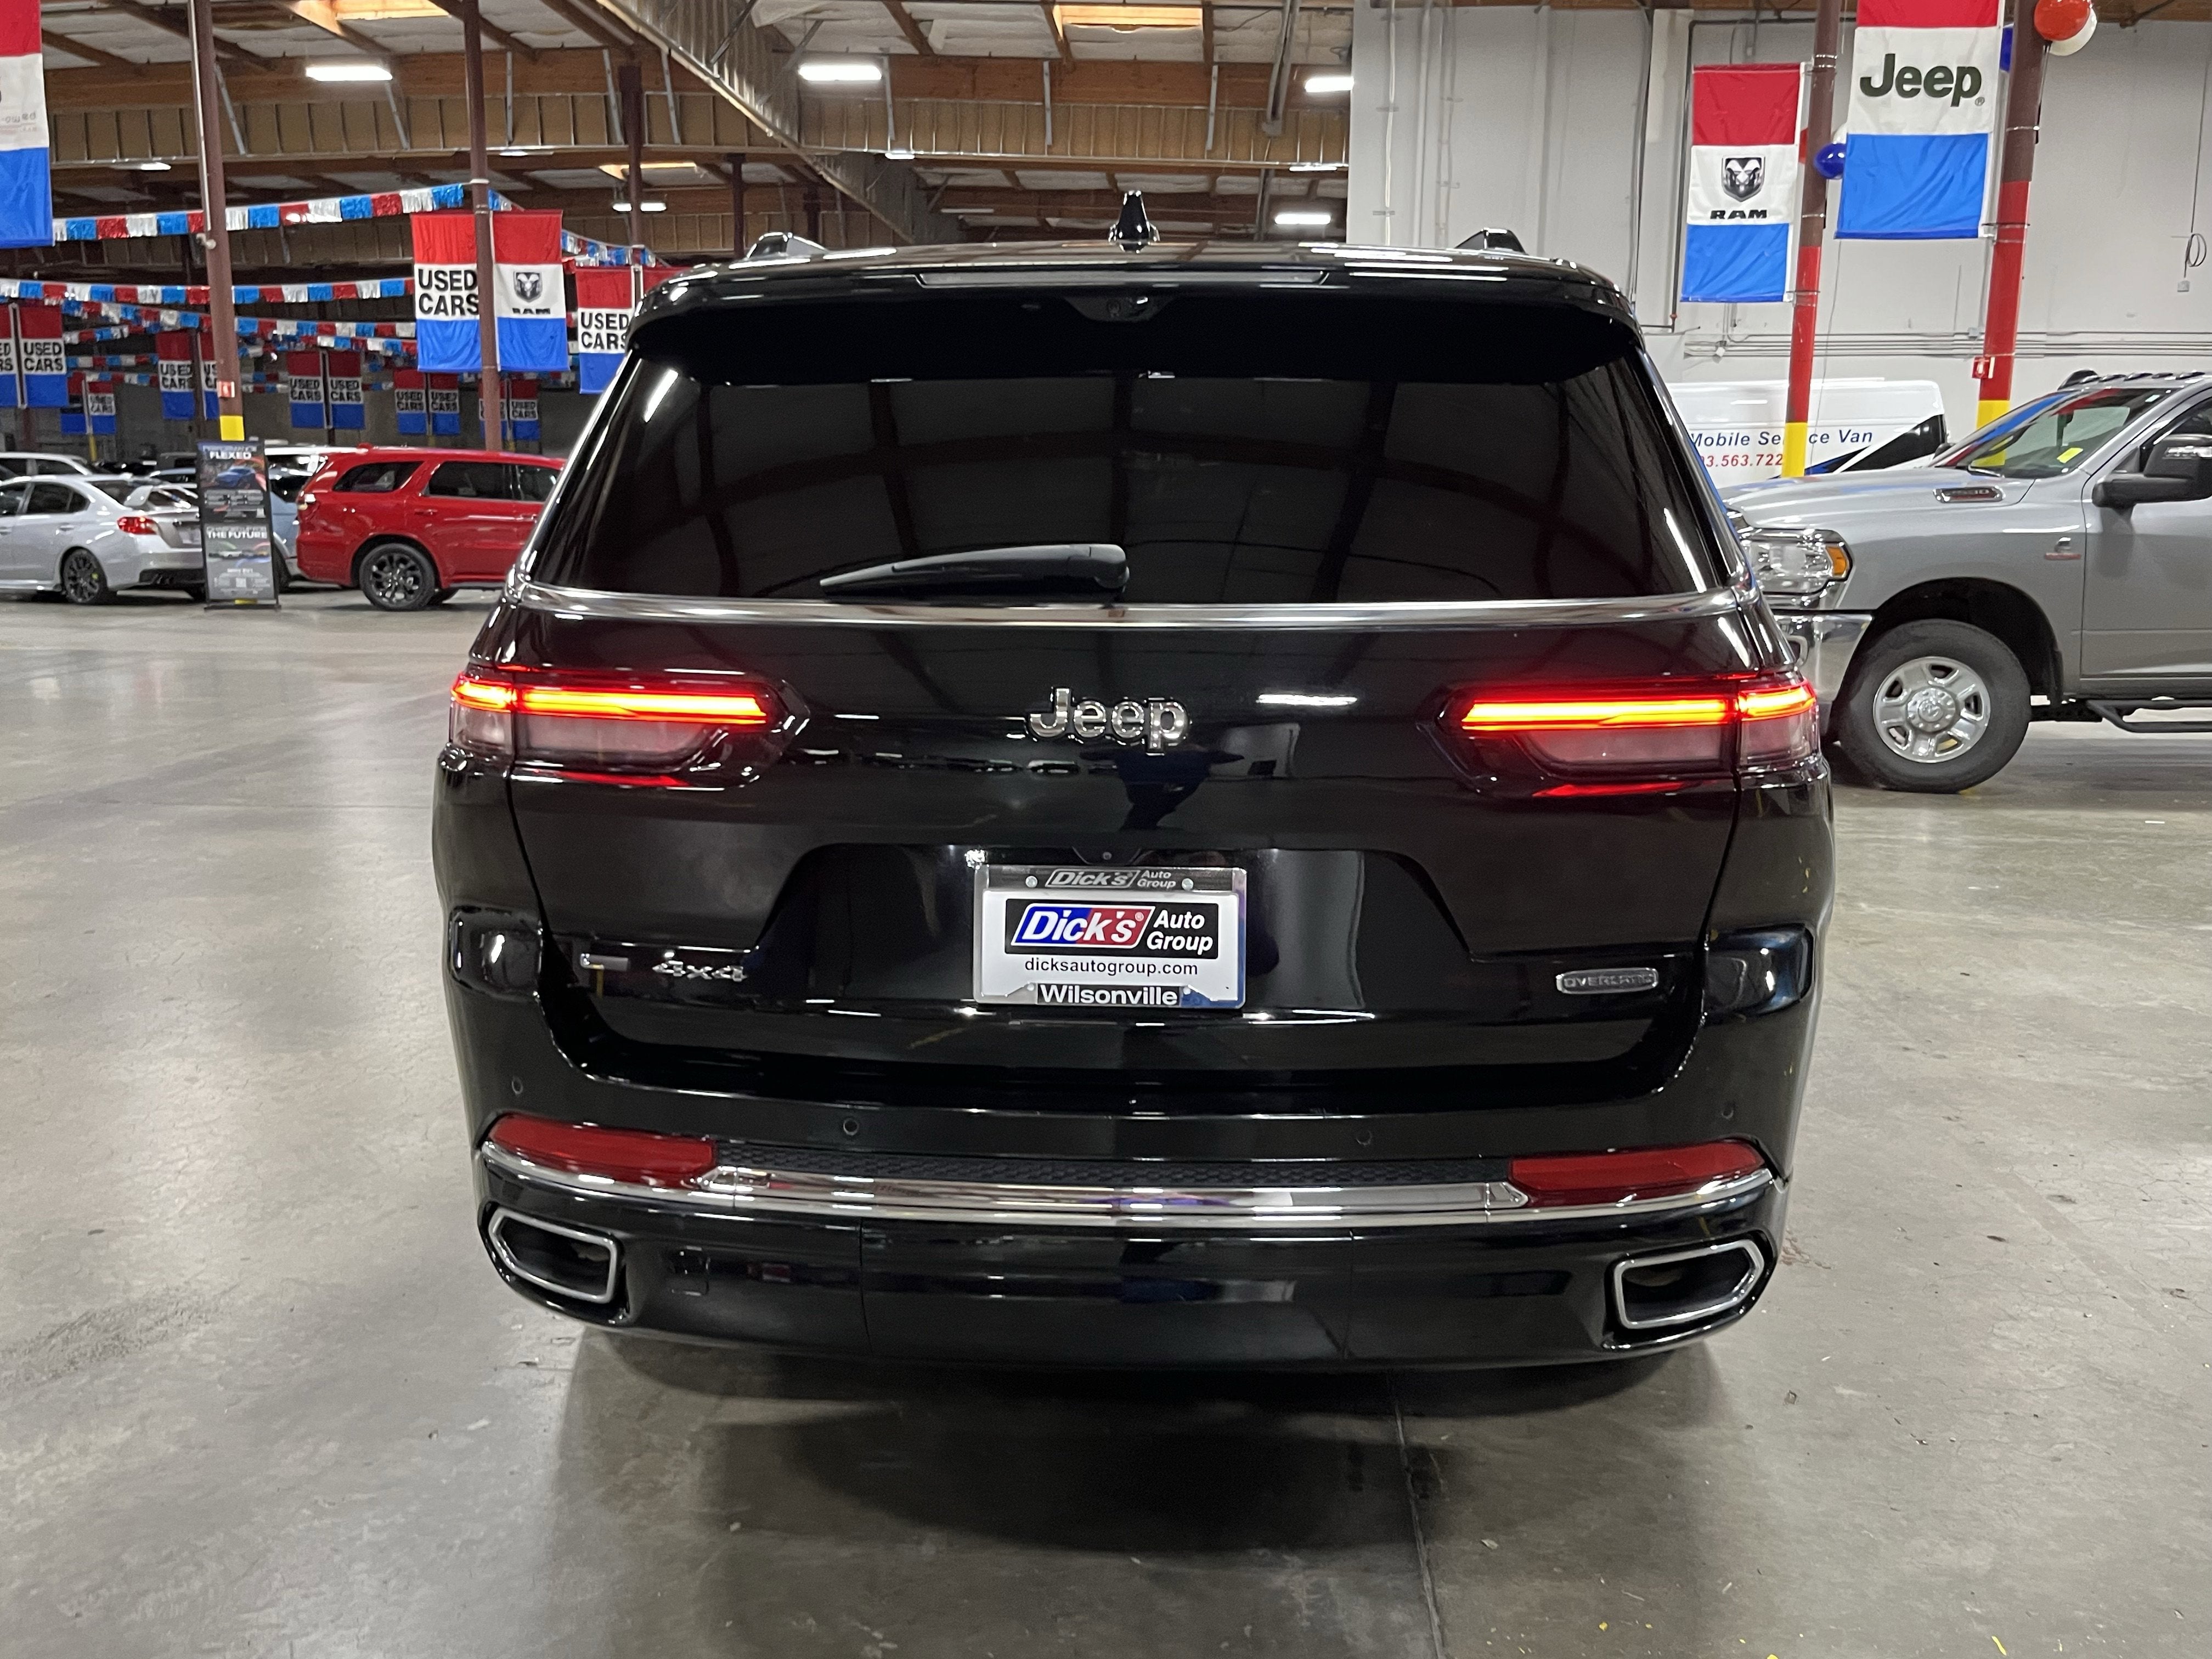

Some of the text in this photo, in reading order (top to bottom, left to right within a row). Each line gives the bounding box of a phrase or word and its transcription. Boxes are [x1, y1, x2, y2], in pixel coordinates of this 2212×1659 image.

[1859, 53, 1982, 108] Jeep
[1710, 210, 1767, 219] RAM
[418, 269, 478, 291] USED
[419, 293, 479, 317] CARS
[581, 312, 629, 330] USED
[24, 342, 62, 356] USED
[581, 331, 627, 350] CARS
[24, 358, 64, 372] CARS
[161, 363, 191, 376] USED
[291, 378, 320, 390] USED
[330, 379, 360, 391] USED
[291, 390, 321, 400] CARS
[330, 391, 361, 402] CARS
[1691, 430, 1873, 447] Mobile Sece Van
[1701, 453, 1784, 467] 3.563.722
[1028, 686, 1189, 755] Jeep
[1051, 871, 1128, 885] Dick's
[1141, 870, 1172, 879] Auto
[1137, 878, 1177, 889] Group
[1022, 909, 1137, 944] Dick's
[1153, 909, 1205, 929] Auto
[1147, 931, 1214, 956] Group
[652, 960, 748, 982] 4x4
[1025, 958, 1198, 977] dicksautogroup.com
[1040, 984, 1178, 1006] Wilsonville
